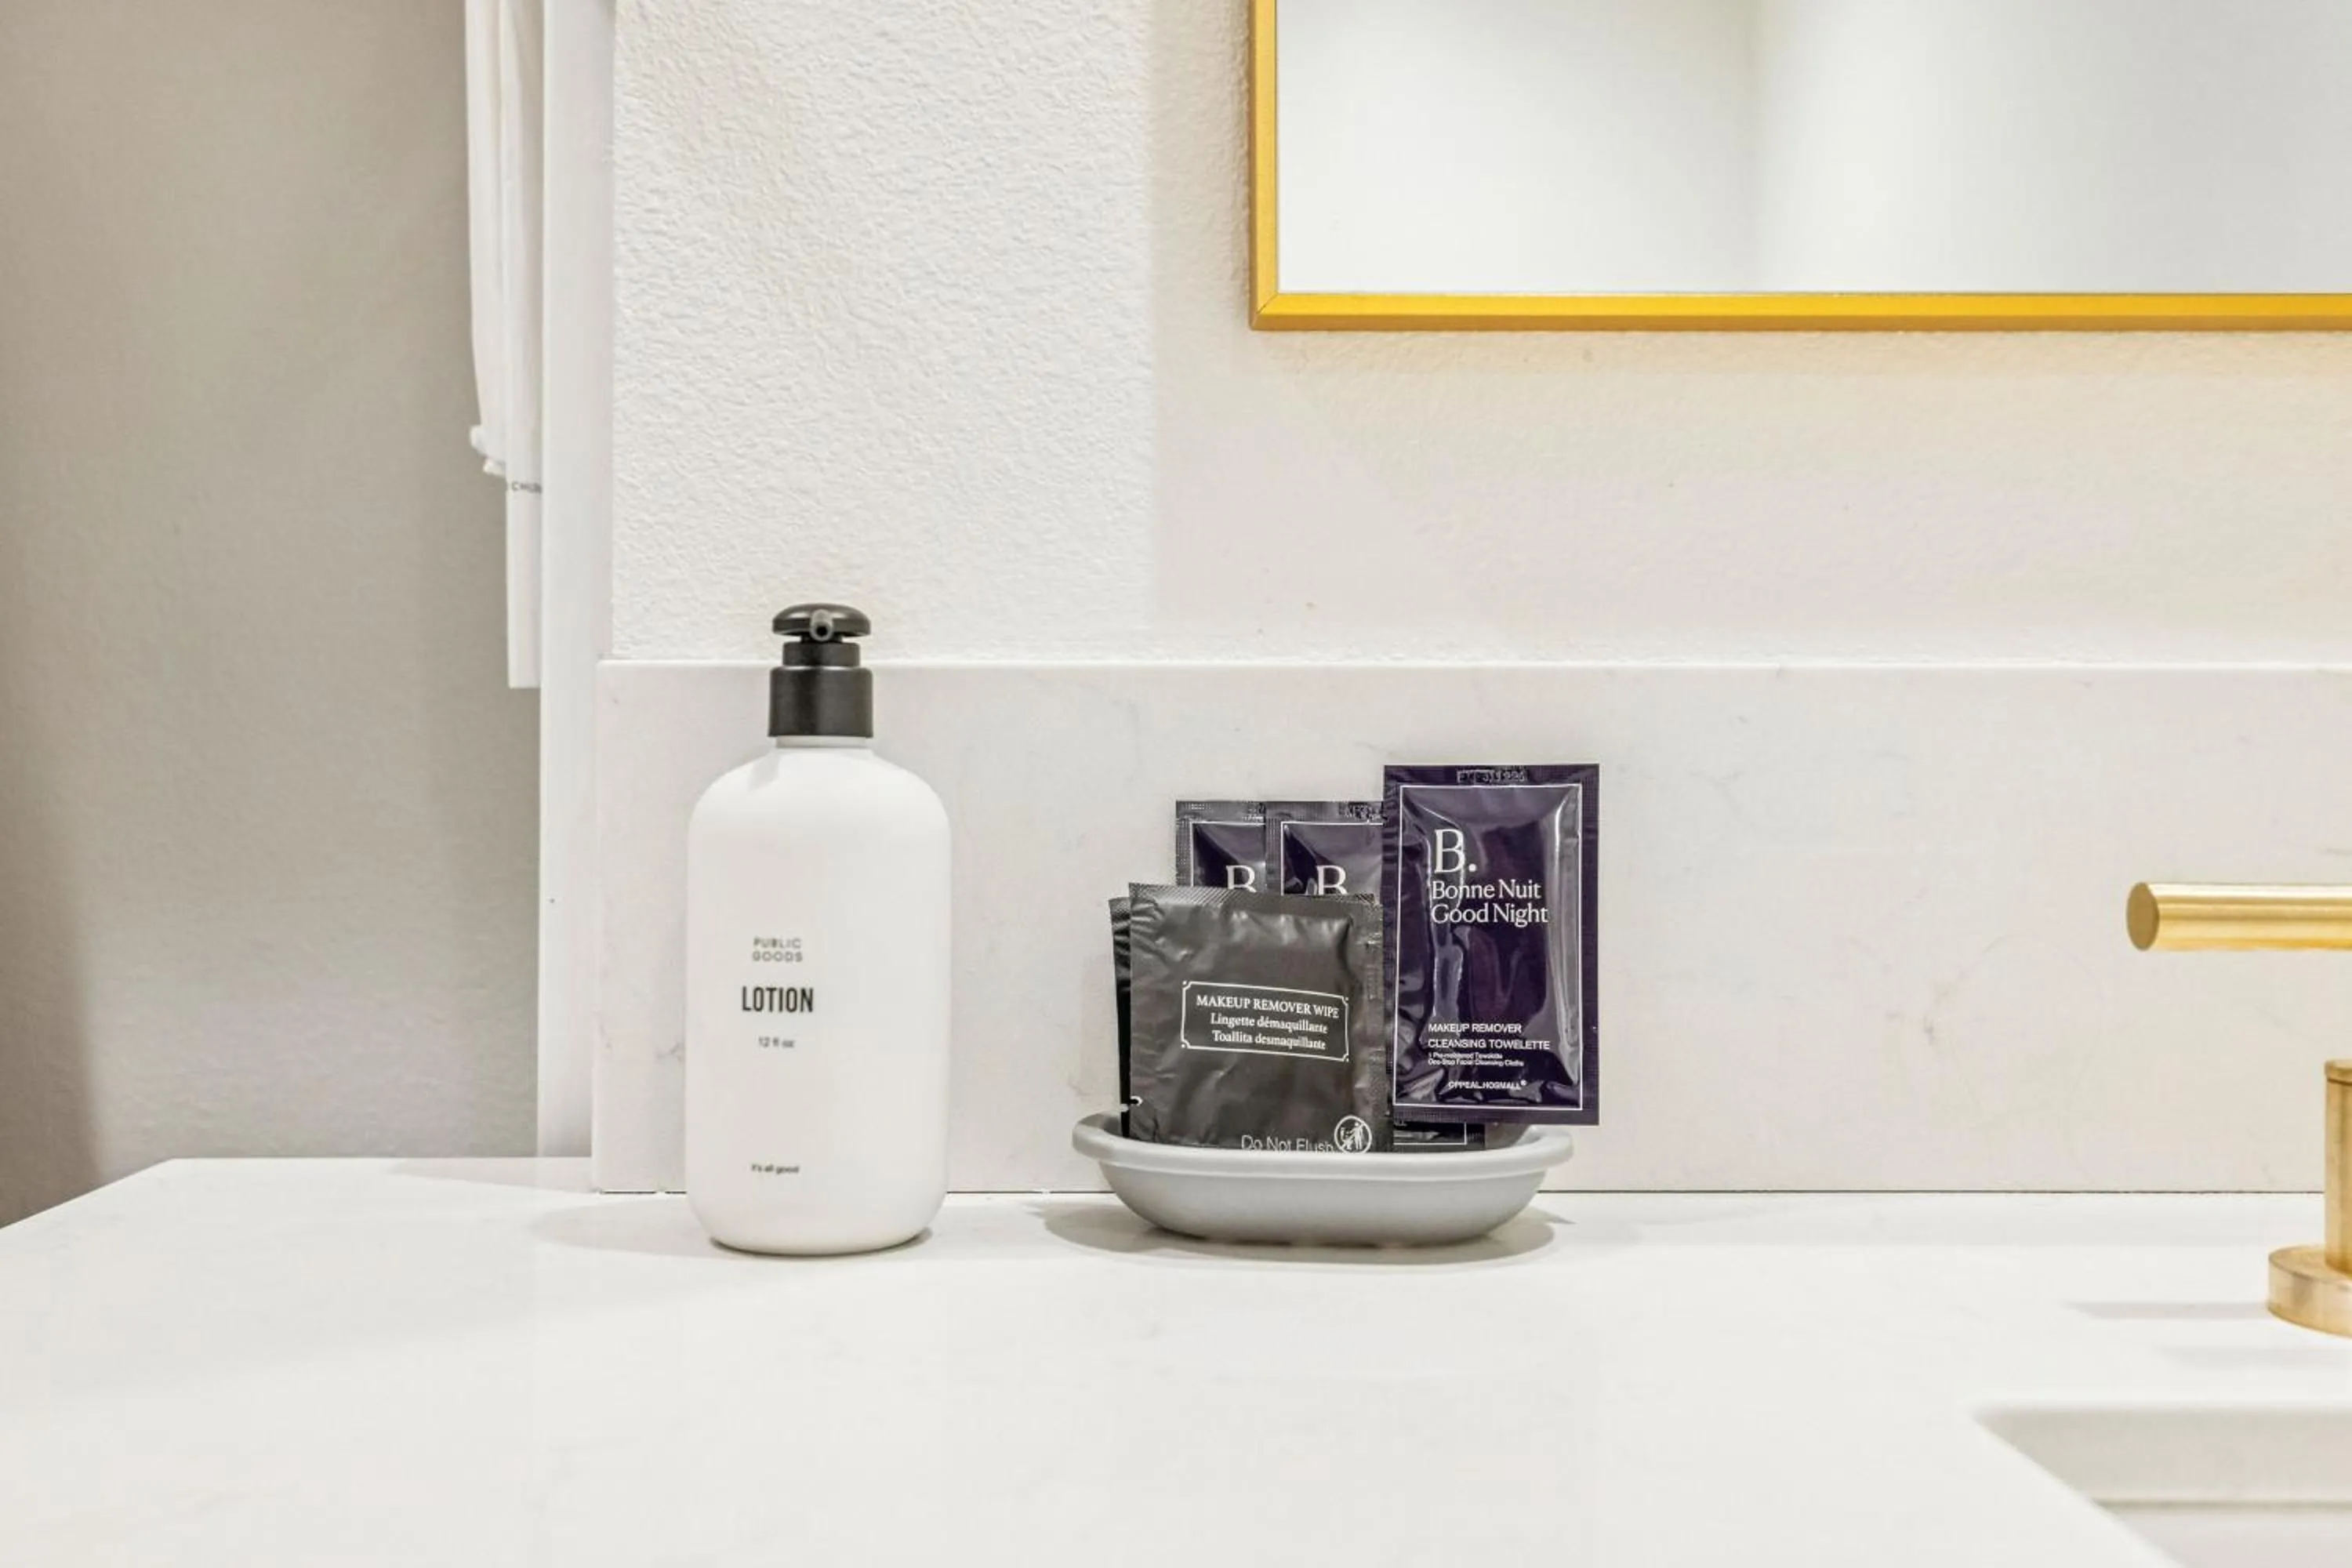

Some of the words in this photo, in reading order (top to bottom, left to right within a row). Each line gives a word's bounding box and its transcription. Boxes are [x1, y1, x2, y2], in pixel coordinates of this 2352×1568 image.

[1434, 828, 1477, 873] B.
[1432, 880, 1496, 900] Bonne
[1498, 879, 1542, 899] Nuit
[1432, 902, 1489, 924] Good
[1492, 902, 1549, 927] Night
[753, 938, 802, 949] PUBLIC
[752, 950, 804, 962] GOODS
[742, 985, 814, 1013] LOTION
[1196, 995, 1250, 1009] MAKEUP
[1253, 998, 1311, 1015] REMOVER
[1312, 1004, 1340, 1018] WIPE
[1210, 1012, 1255, 1029] Lingette
[1257, 1014, 1328, 1034] démaquillante
[1428, 1023, 1470, 1033] MAKEUP
[1472, 1023, 1523, 1034] REMOVER
[759, 1036, 771, 1048] 12
[772, 1036, 780, 1047] fl
[782, 1039, 795, 1049] oz
[1211, 1029, 1254, 1044] Toallita
[1255, 1033, 1327, 1051] desmaquillante
[1428, 1038, 1487, 1049] CLEANSING
[1489, 1039, 1551, 1051] TOWELETTE
[1241, 1134, 1263, 1150] Do
[1266, 1136, 1292, 1152] Not
[1296, 1138, 1334, 1153] Flush
